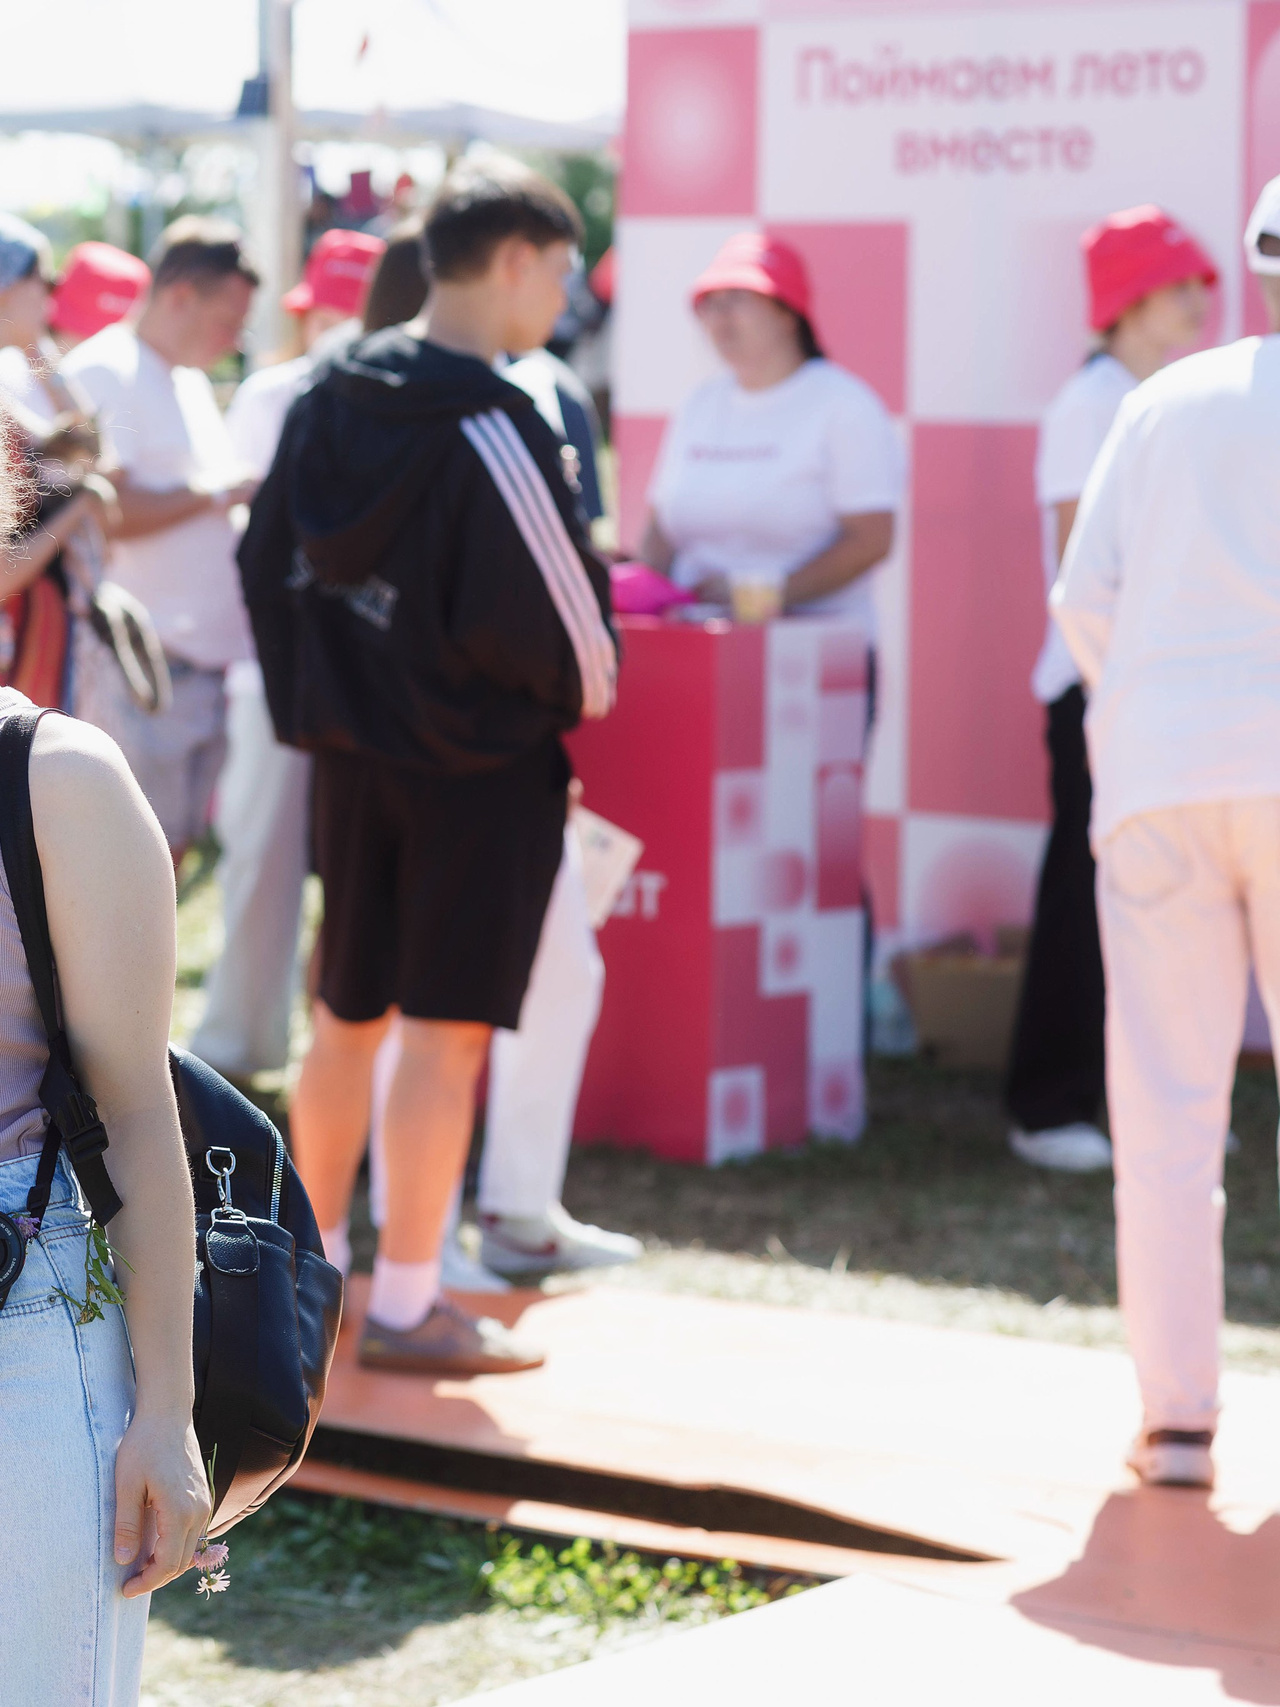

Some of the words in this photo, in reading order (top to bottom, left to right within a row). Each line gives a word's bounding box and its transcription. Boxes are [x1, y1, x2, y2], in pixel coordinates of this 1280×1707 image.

[796, 44, 1056, 104] Поймаем
[1071, 48, 1205, 97] лето
[895, 127, 1095, 174] вместе
